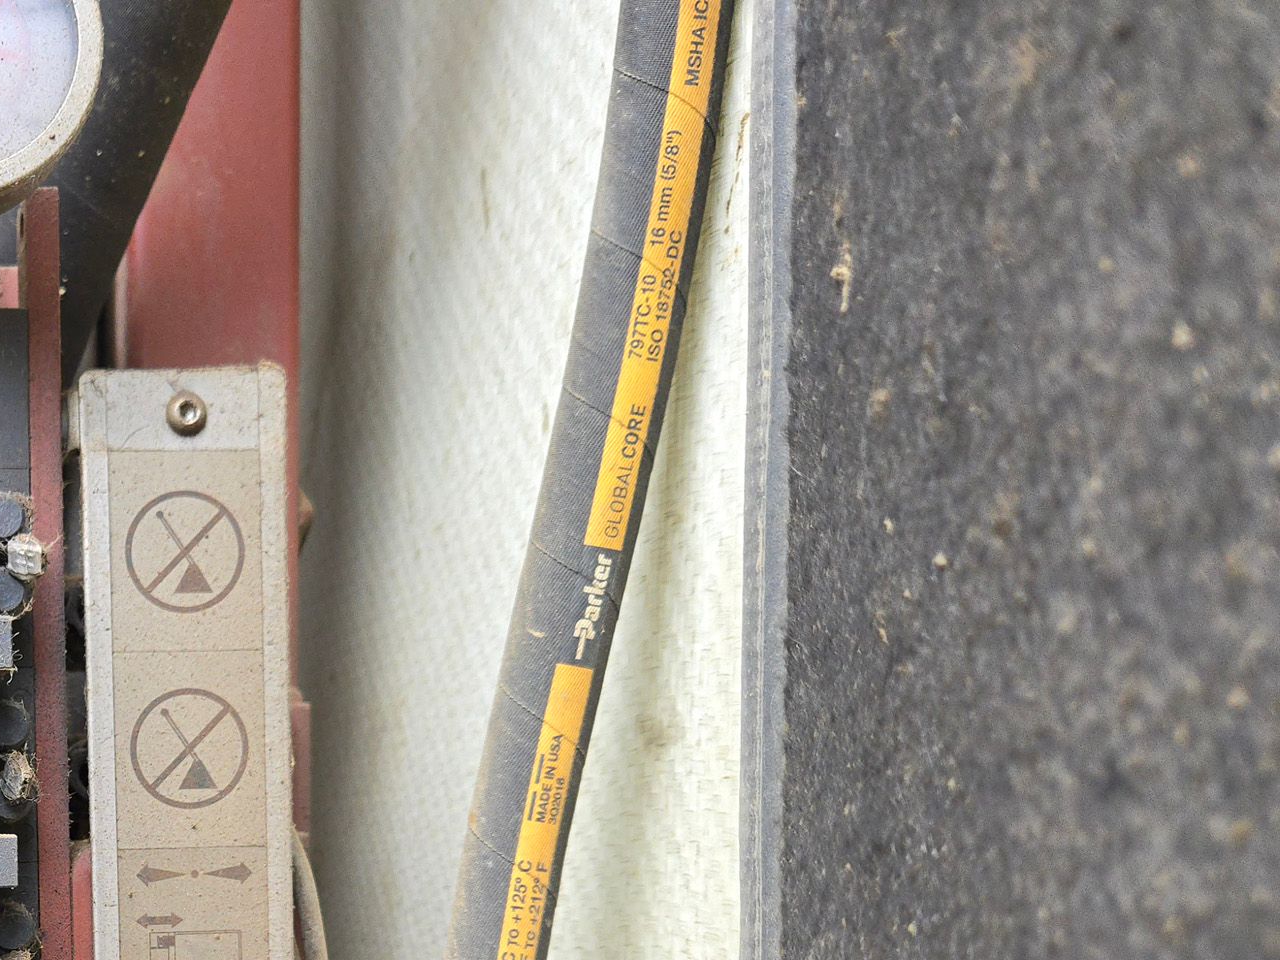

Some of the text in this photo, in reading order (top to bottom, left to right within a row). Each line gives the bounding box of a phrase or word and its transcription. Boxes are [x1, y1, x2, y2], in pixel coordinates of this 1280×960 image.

[684, 26, 707, 87] MSHA
[650, 130, 682, 247] 16 mm (5/8")
[628, 274, 657, 358] 797TC-10
[646, 230, 683, 362] ISO 18752-DC
[605, 403, 647, 539] GLOBALCORE
[573, 553, 612, 640] Parker
[535, 733, 564, 823] MADE IN USA
[518, 860, 532, 873] C
[536, 861, 548, 873] F
